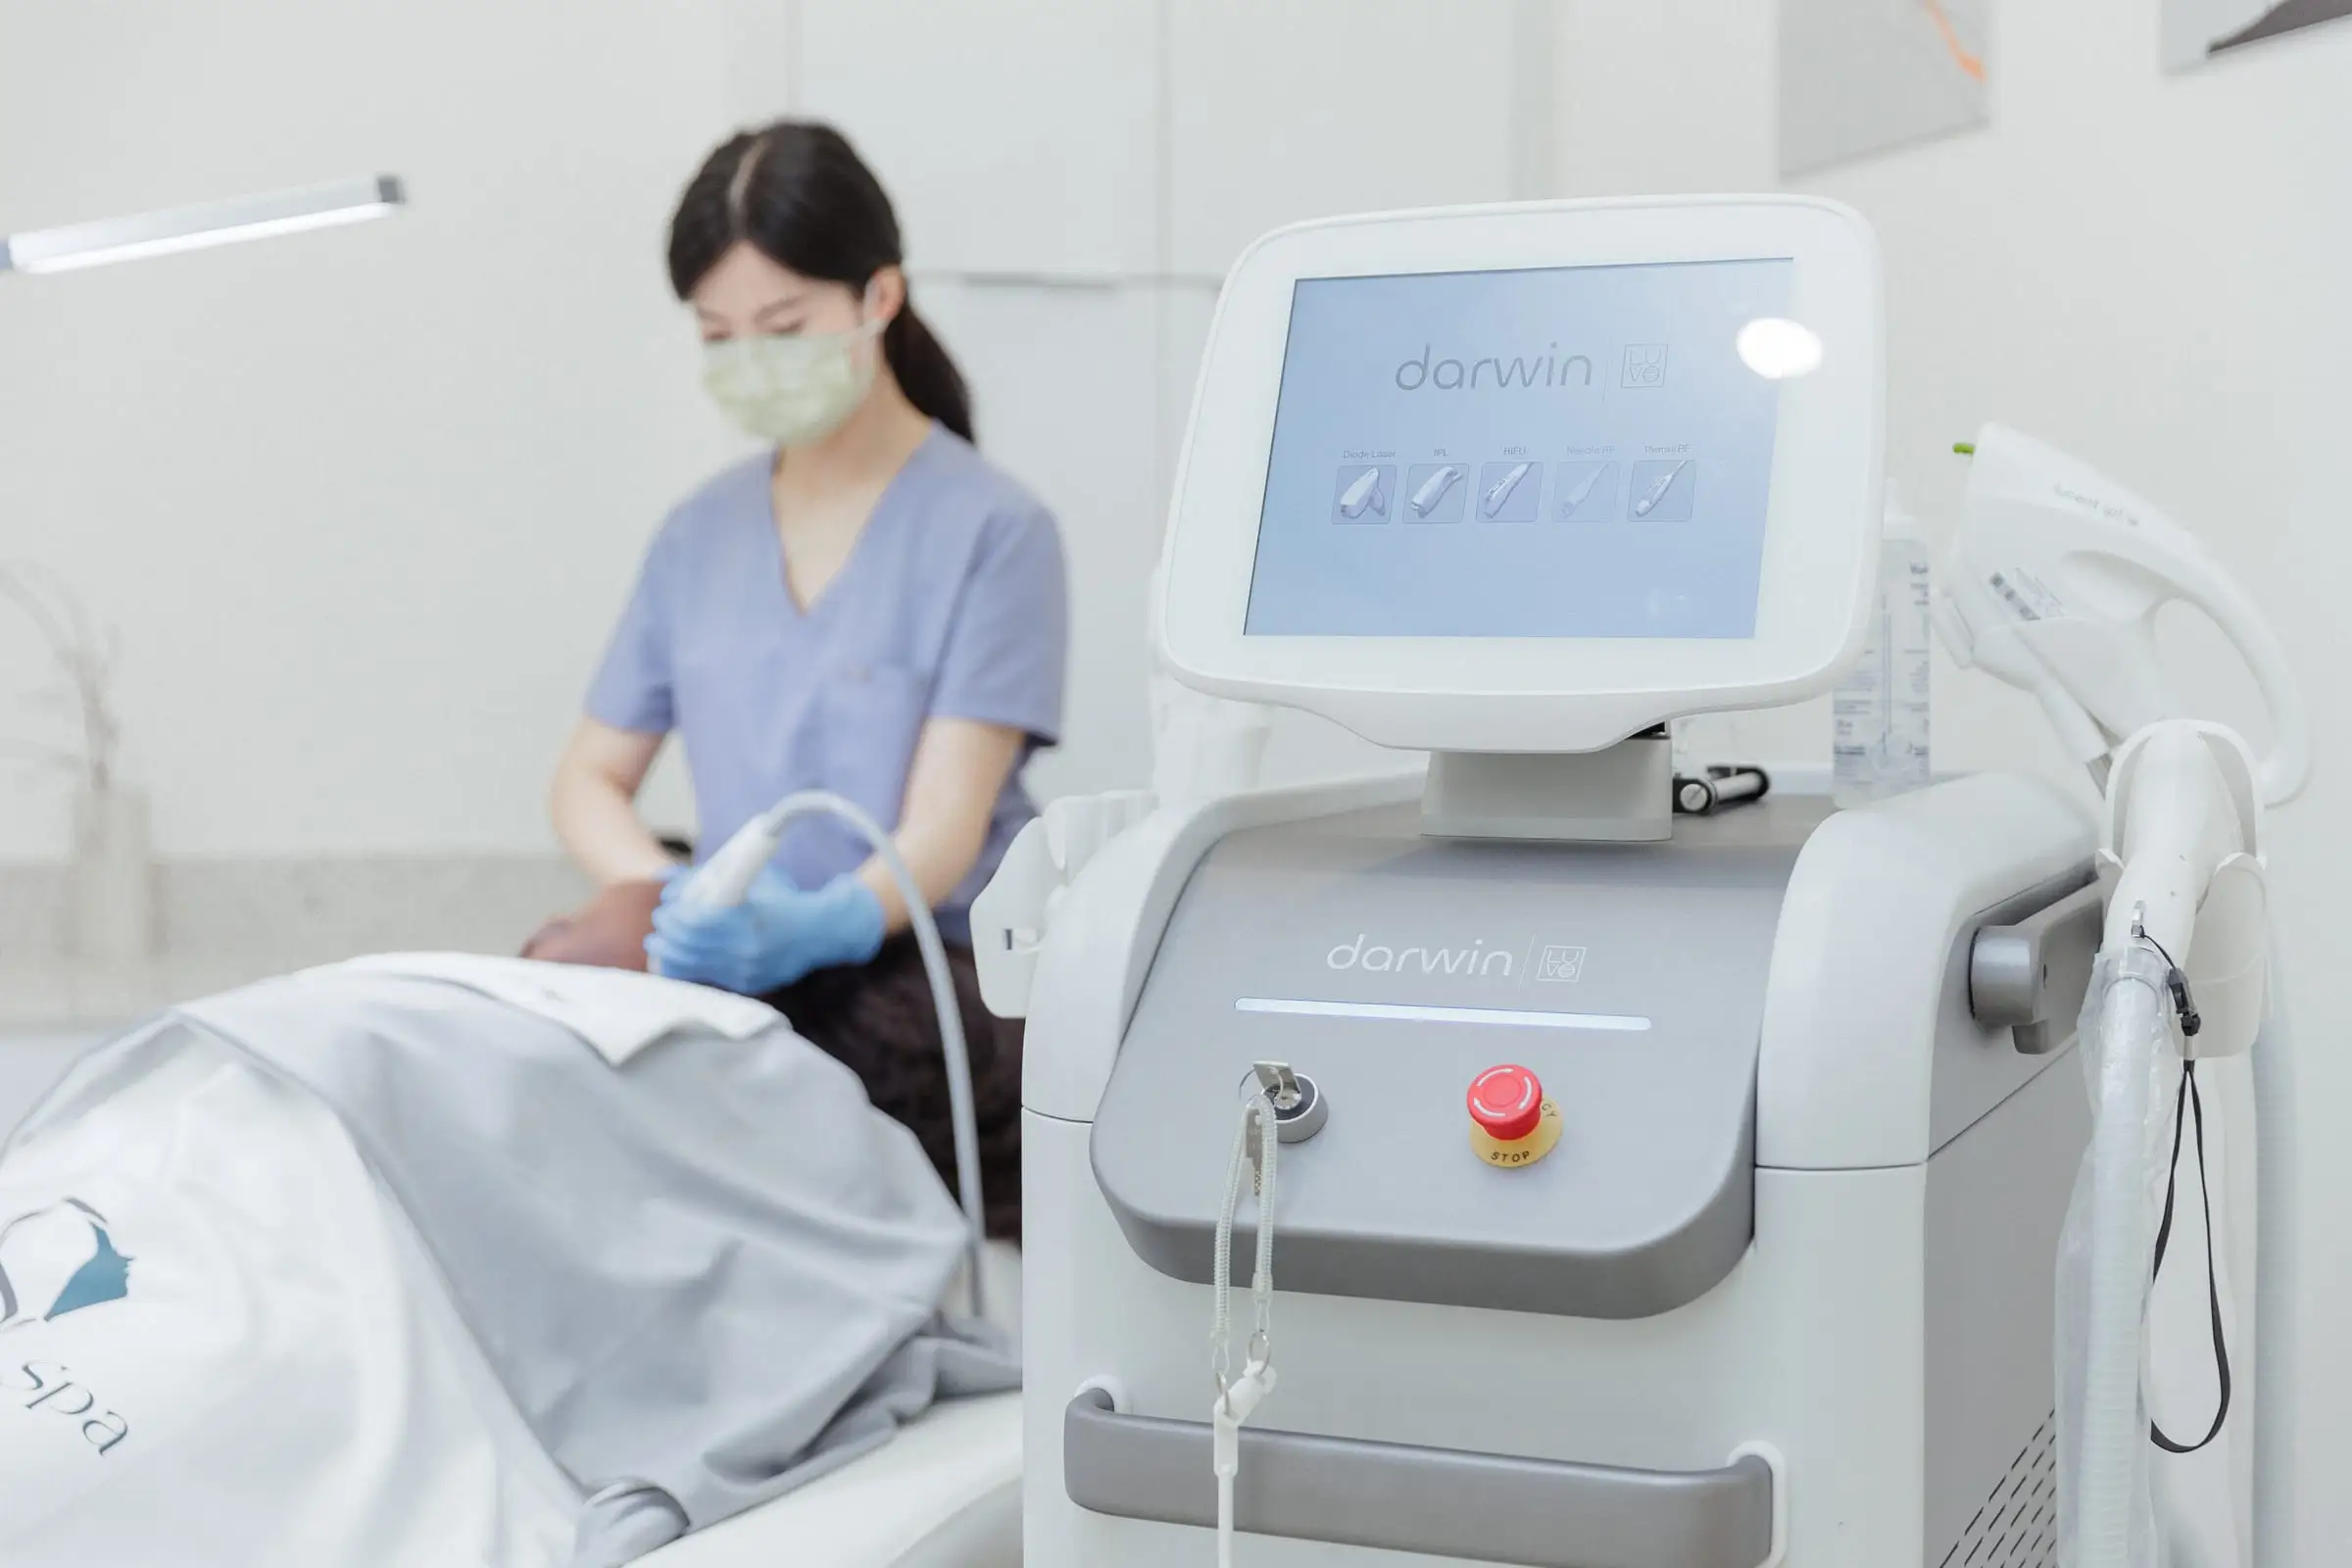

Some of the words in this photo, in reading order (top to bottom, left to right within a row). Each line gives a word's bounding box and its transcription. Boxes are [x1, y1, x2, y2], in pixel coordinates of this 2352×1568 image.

[1396, 342, 1592, 391] darwin
[1342, 449, 1370, 460] Diode
[1372, 448, 1396, 459] Laser
[1434, 447, 1448, 458] IPL
[1327, 934, 1512, 976] darwin
[1490, 1151, 1531, 1162] STOP
[0, 1358, 129, 1458] spa
